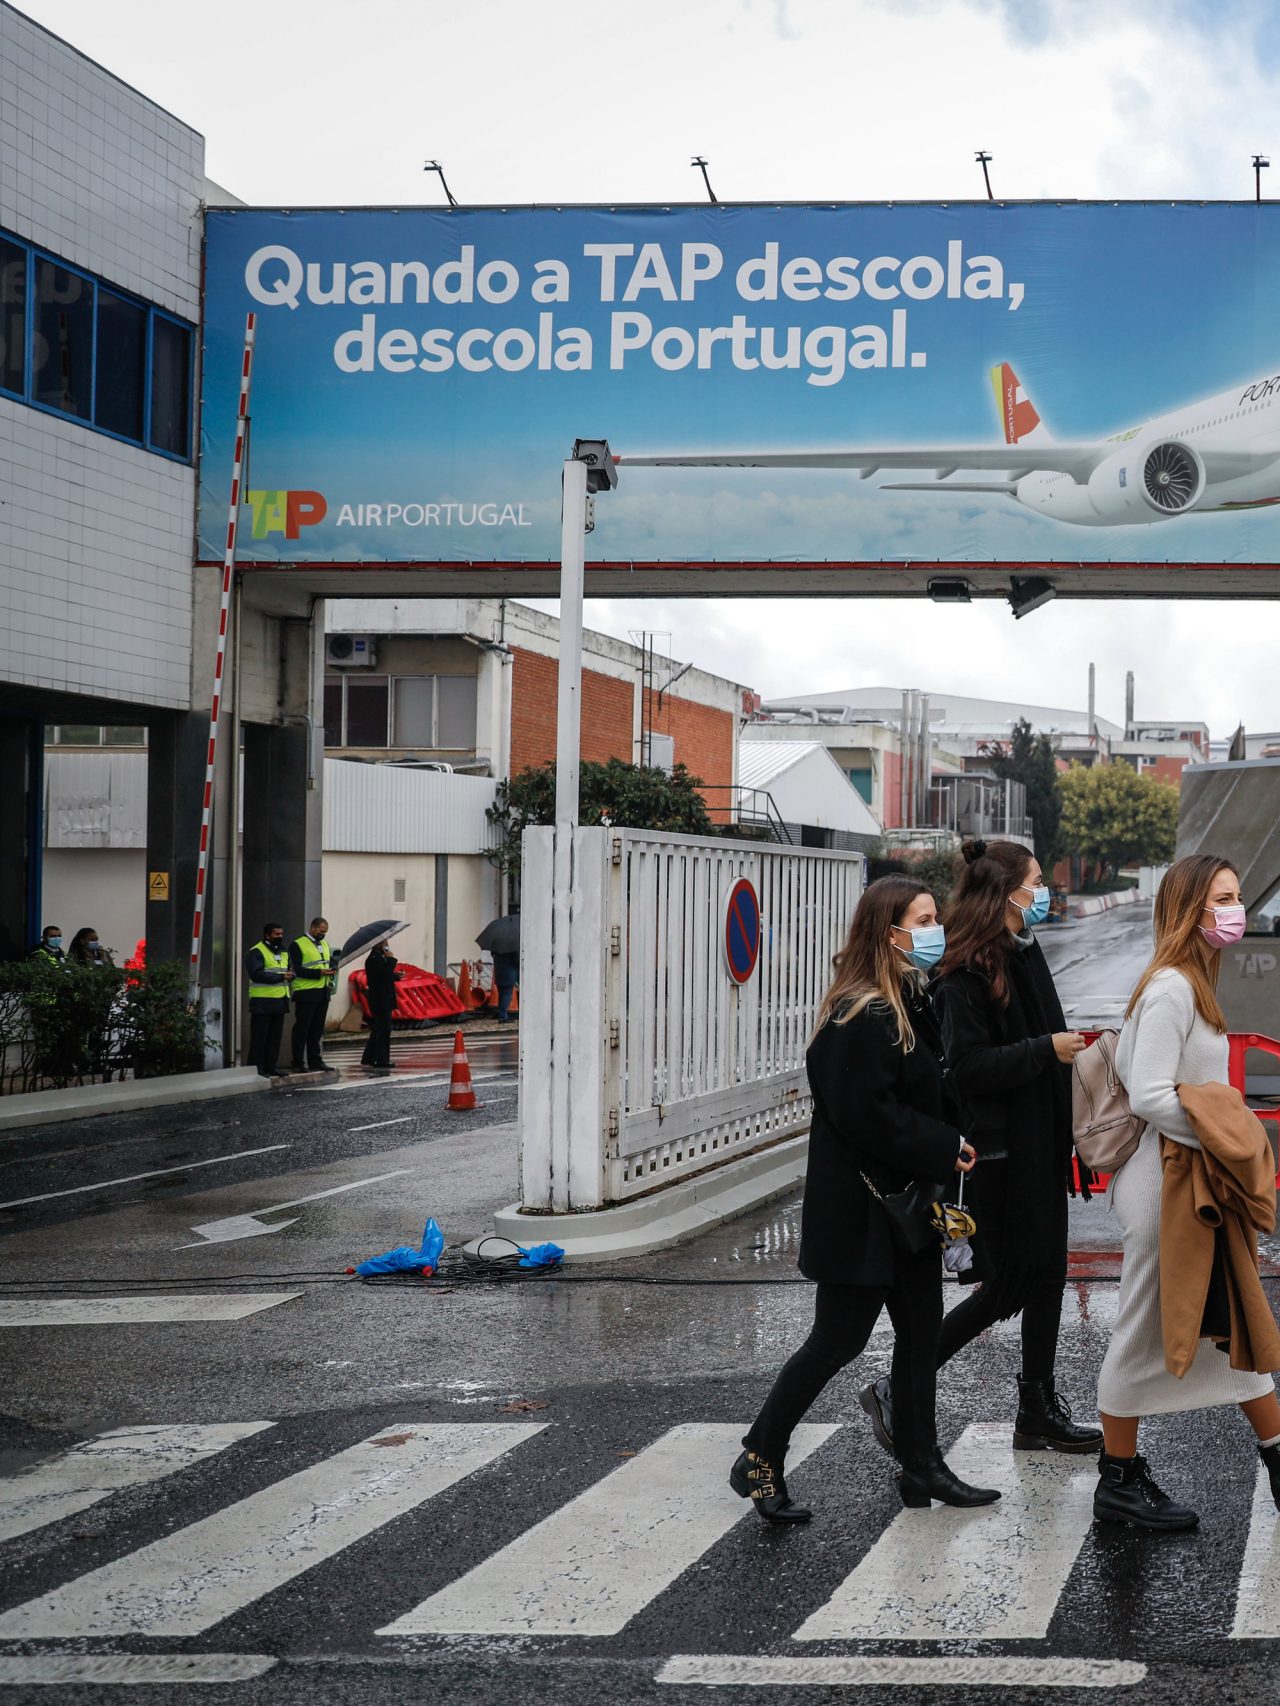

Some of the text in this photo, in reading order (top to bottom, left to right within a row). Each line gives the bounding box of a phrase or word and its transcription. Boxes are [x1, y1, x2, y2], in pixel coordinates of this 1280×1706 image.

[245, 240, 1025, 311] Quando a TAP descola,
[333, 308, 927, 387] descola Portugal.
[246, 490, 328, 540] TAP
